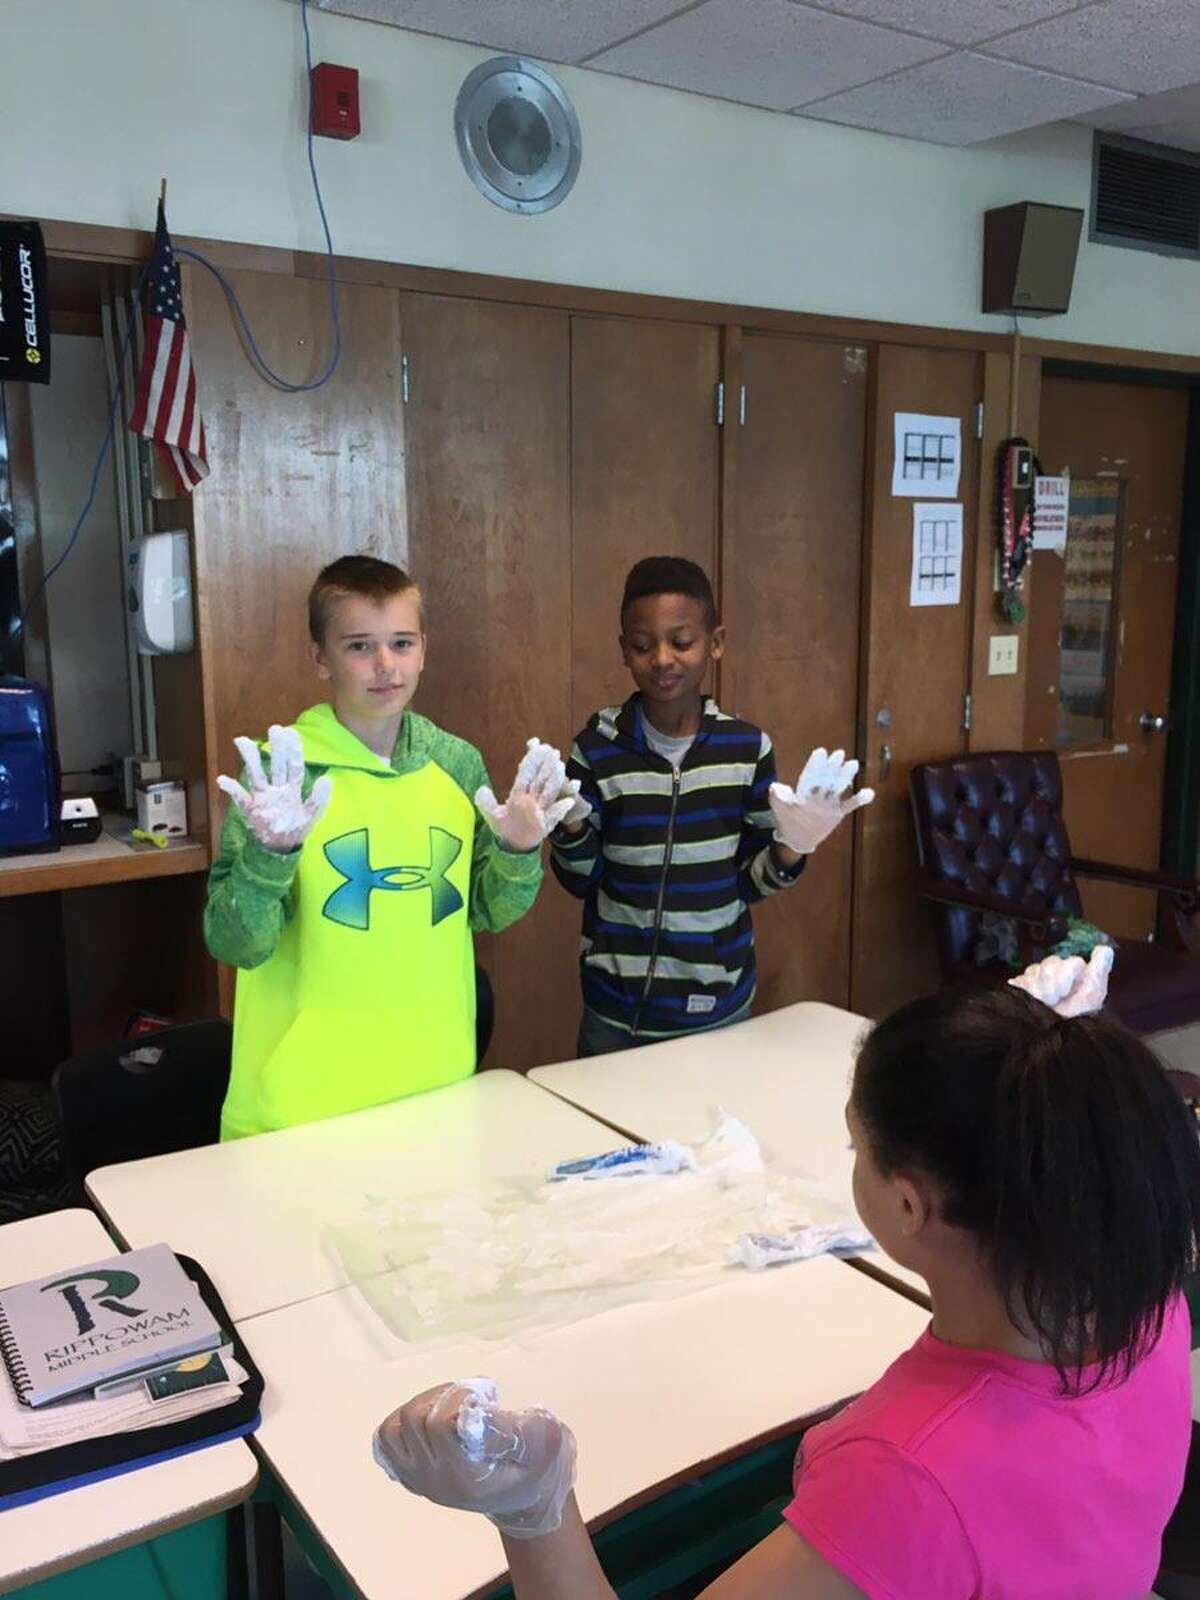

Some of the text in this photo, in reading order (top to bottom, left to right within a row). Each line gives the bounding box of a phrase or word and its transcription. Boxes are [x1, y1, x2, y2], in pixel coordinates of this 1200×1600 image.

[19, 248, 37, 347] CELLUCOR
[43, 1307, 191, 1363] RIPPOWAM
[48, 1319, 191, 1373] MIDDLE SCHOOL
